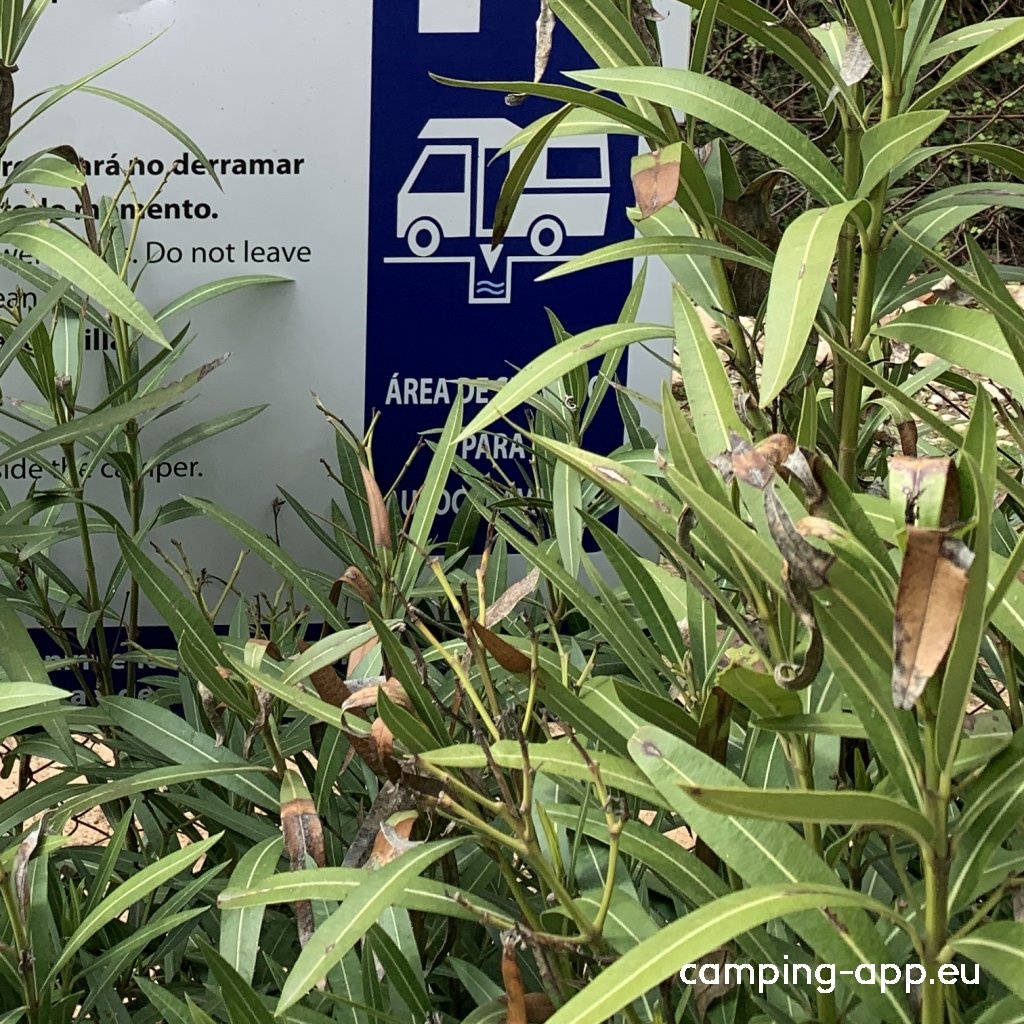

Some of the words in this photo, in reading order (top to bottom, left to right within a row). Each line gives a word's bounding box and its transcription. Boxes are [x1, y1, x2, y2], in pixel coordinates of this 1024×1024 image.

[129, 159, 165, 176] no
[173, 153, 305, 176] derramar
[75, 198, 219, 220] mmento.
[146, 242, 185, 264] Do
[192, 243, 235, 264] not
[244, 240, 312, 264] leave
[385, 373, 451, 405] ÁREA
[461, 432, 526, 460] PARA
